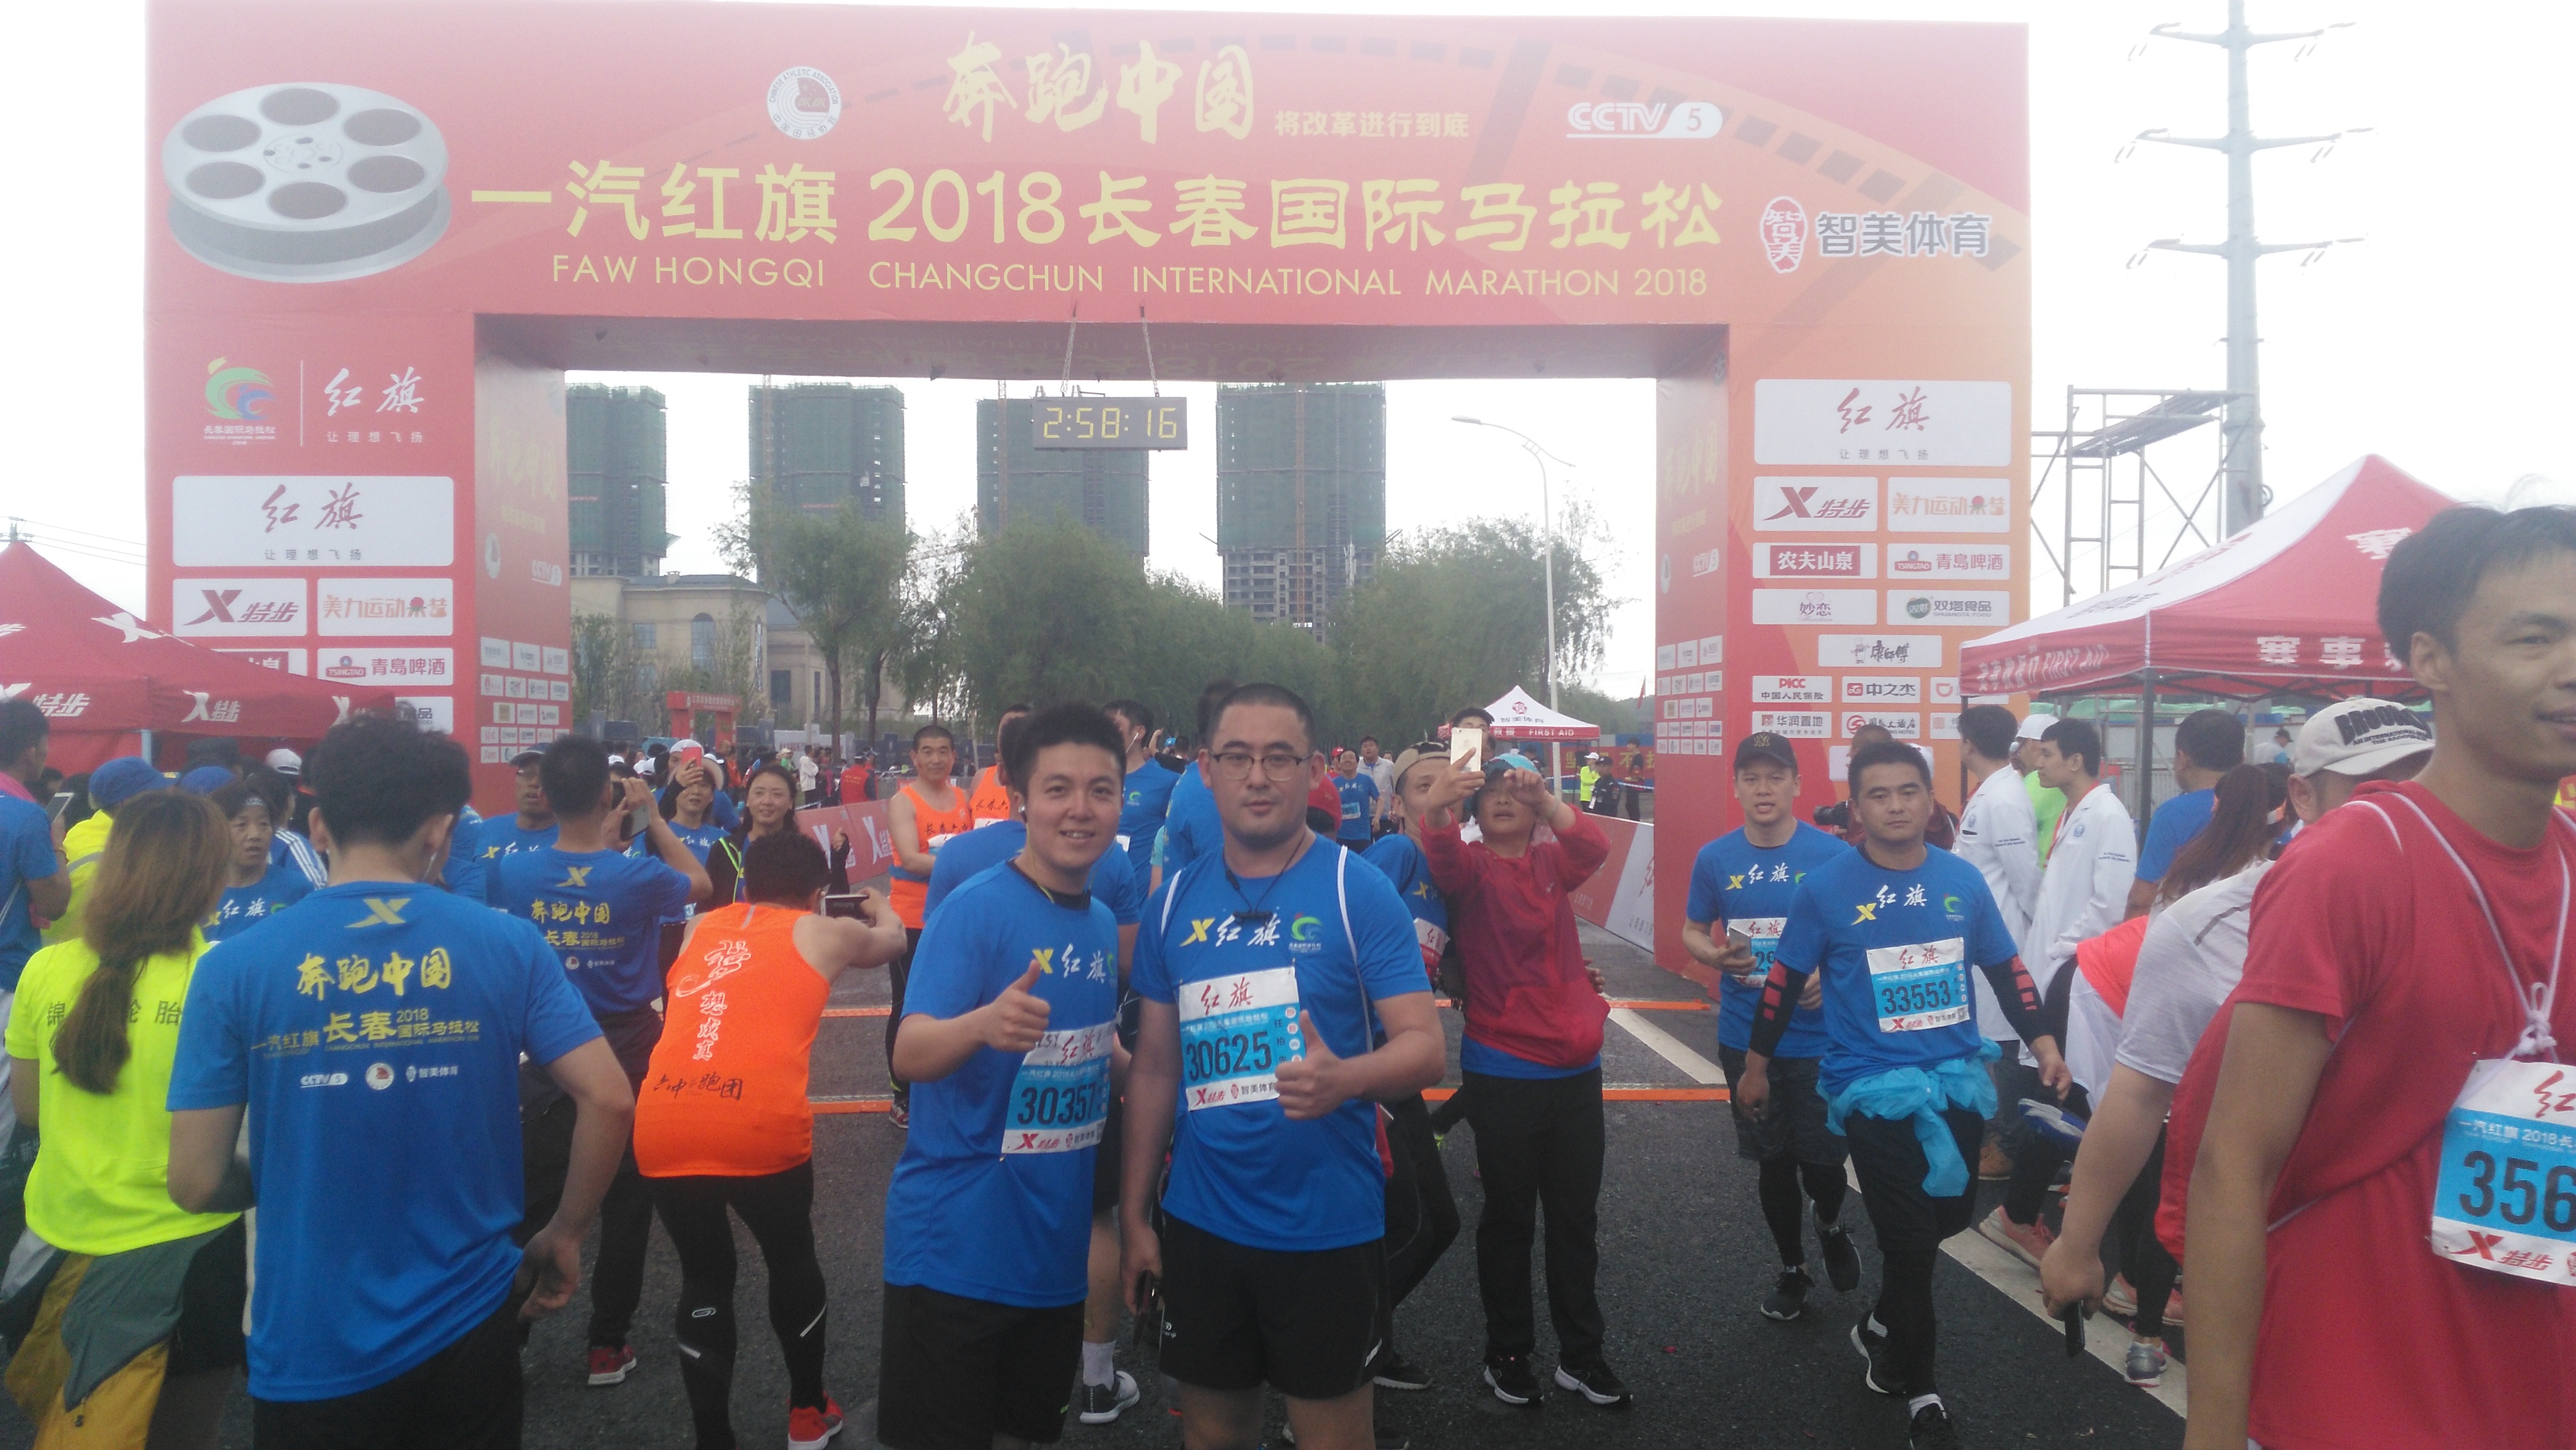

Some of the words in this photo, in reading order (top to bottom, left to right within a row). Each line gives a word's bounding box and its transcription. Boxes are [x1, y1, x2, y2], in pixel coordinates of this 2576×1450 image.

[769, 78, 784, 103] CHINESE
[783, 69, 811, 81] ATHLETIC
[812, 72, 839, 105] ASSOCIATION
[942, 30, 1255, 145] 奔跑中国
[1275, 111, 1470, 139] 将改革进行到底
[1566, 103, 1667, 132] CCTV
[471, 159, 837, 245] 一汽红旗
[1816, 211, 1992, 257] 智美体育
[553, 254, 637, 282] FAW
[656, 256, 825, 288] HONGQI
[869, 261, 1103, 292] CHANGCHUN
[1133, 265, 1401, 296] INTERNATIONAL
[1425, 268, 1619, 296] MARATHON
[1634, 268, 1707, 296] 2018
[323, 367, 425, 417] 红旗
[1837, 386, 1930, 434] 红旗
[1043, 407, 1177, 439] 2:58:16
[326, 430, 422, 443] 让理想飞扬
[1839, 448, 1929, 460] 让理想飞扬
[261, 482, 364, 533] 红旗
[1814, 498, 1871, 519] 特步
[264, 549, 362, 562] 让理想飞扬
[1778, 551, 1854, 571] 农夫山泉
[1896, 562, 1930, 570] TSINGTAO
[238, 601, 299, 623] 特步
[1799, 601, 1832, 617] 妙恋
[1934, 600, 1992, 612] 双塔食品
[2042, 647, 2081, 681] FIRST
[2079, 644, 2110, 671] AID
[1761, 691, 1824, 701] 中国人民保险
[1778, 678, 1806, 689] PICC
[32, 693, 91, 718] 特步
[1559, 729, 1574, 737] AID
[1777, 715, 1823, 727] 华润置地
[1748, 862, 1789, 885] 红旗
[222, 899, 266, 918] 红旗
[1876, 883, 1928, 909] 红旗
[531, 898, 610, 925] 奔跑中国
[545, 930, 581, 946] 长春
[1215, 913, 1281, 947] 红旗
[1748, 920, 1782, 938] 红旗
[1061, 943, 1106, 984] 红旗
[1899, 945, 1939, 969] 红旗
[297, 947, 451, 1001] 奔跑中国
[1200, 977, 1254, 1016] 红旗
[1881, 980, 1952, 1015] 33553
[397, 1008, 429, 1022] 2018
[251, 1029, 320, 1051] 一汽红旗
[323, 1010, 397, 1043] 长春
[398, 1020, 480, 1039] 国际马拉松
[1061, 1029, 1096, 1064] 红旗
[1186, 1031, 1272, 1081] 30625
[418, 1065, 459, 1078] 智美体育
[1241, 1081, 1276, 1096] 智美体育
[1017, 1082, 1097, 1125] 30357
[2458, 1119, 2519, 1140] 一汽红旗
[2499, 1249, 2555, 1272] 特步
